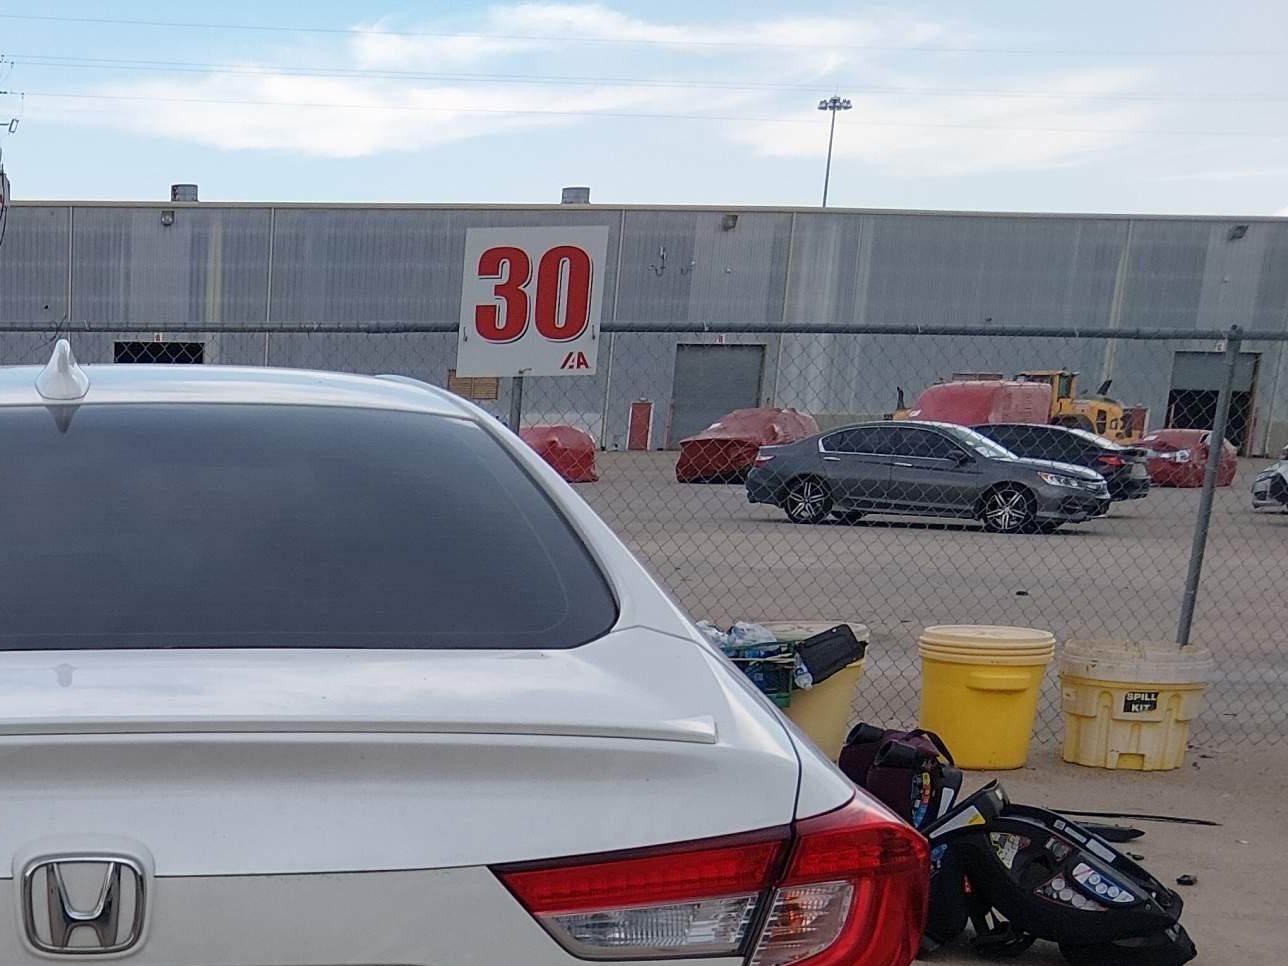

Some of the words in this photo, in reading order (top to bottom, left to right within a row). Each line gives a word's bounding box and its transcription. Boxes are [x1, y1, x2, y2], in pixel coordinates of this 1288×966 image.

[473, 244, 593, 344] 30
[1126, 692, 1157, 701] SPILL
[1131, 703, 1151, 712] KIT
